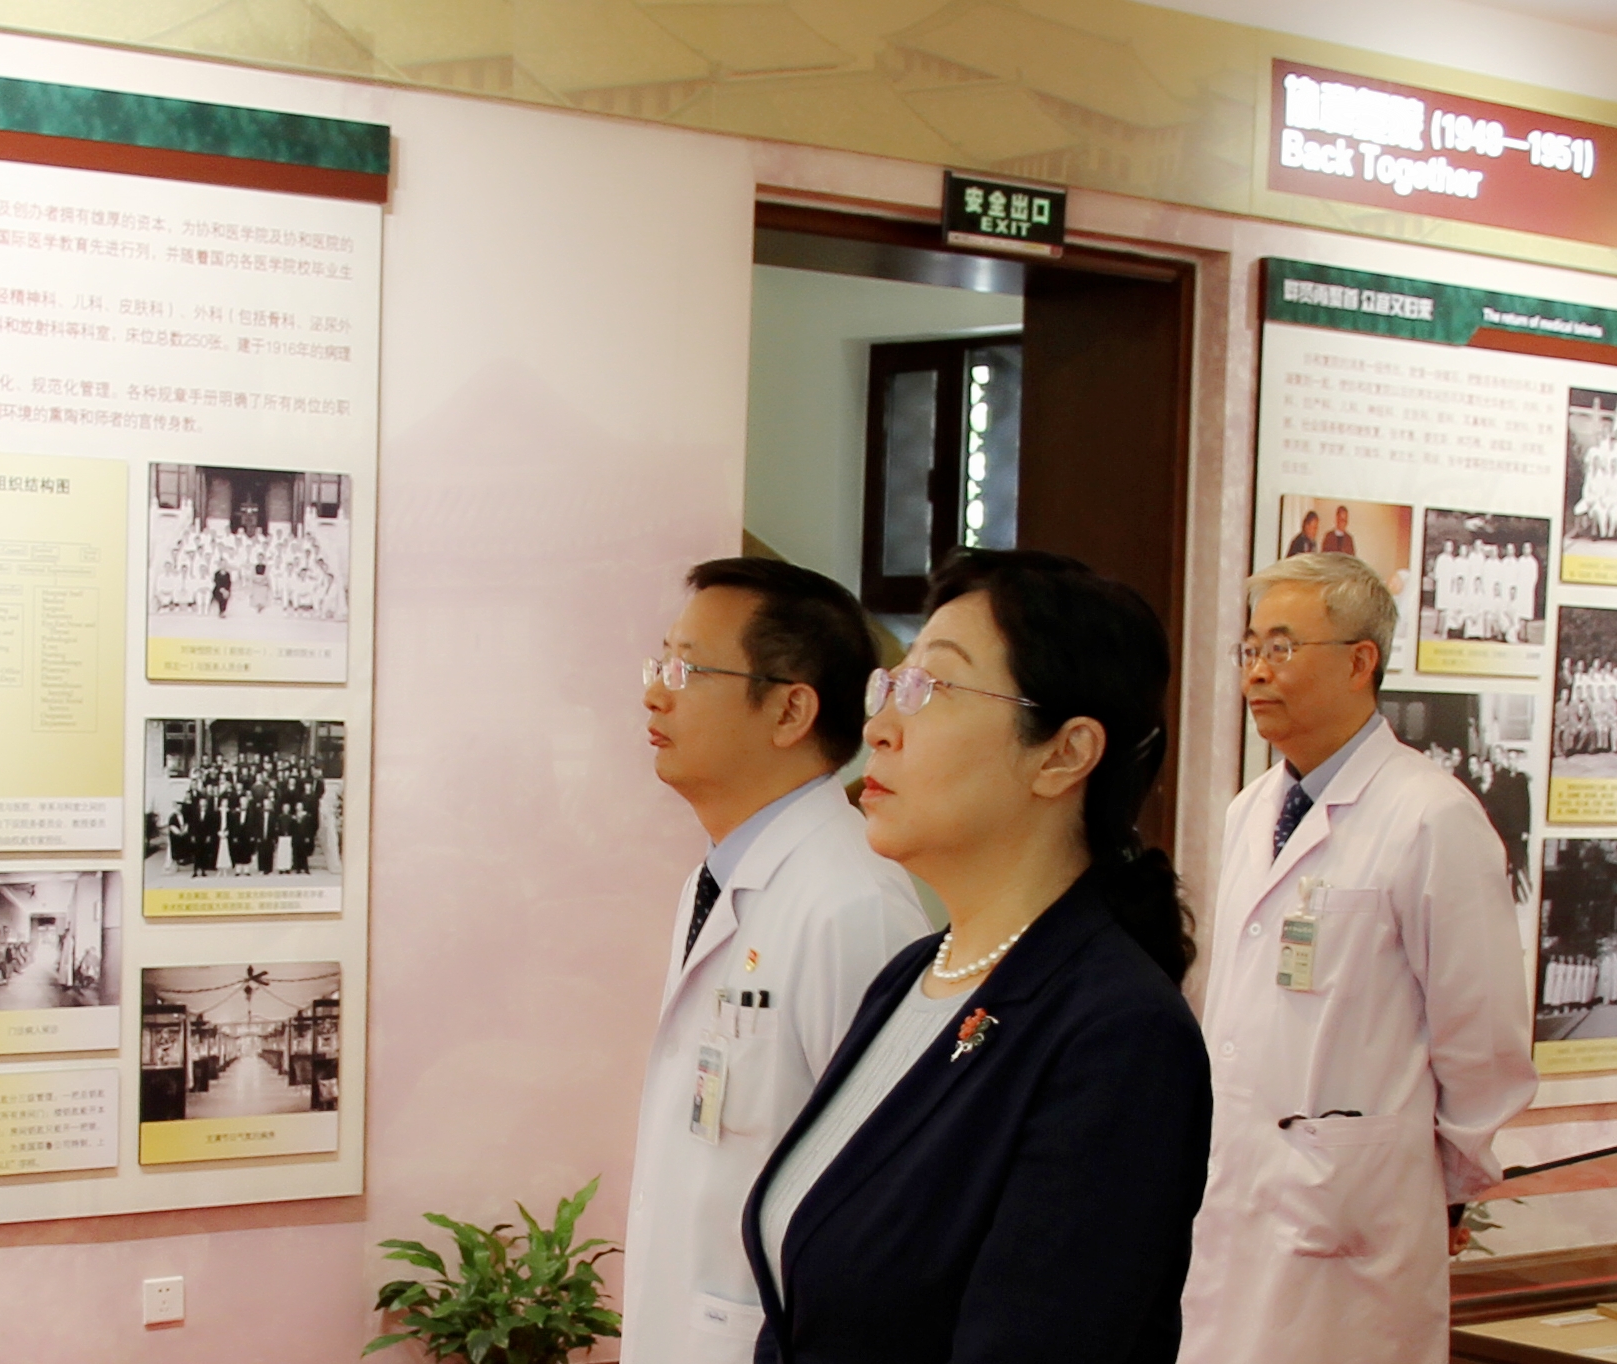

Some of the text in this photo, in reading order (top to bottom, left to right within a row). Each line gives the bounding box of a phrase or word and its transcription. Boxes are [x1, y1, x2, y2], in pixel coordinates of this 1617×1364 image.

[1280, 128, 1484, 200] Back Together
[964, 184, 1052, 226] 安全出口
[979, 217, 1032, 239] EXIT
